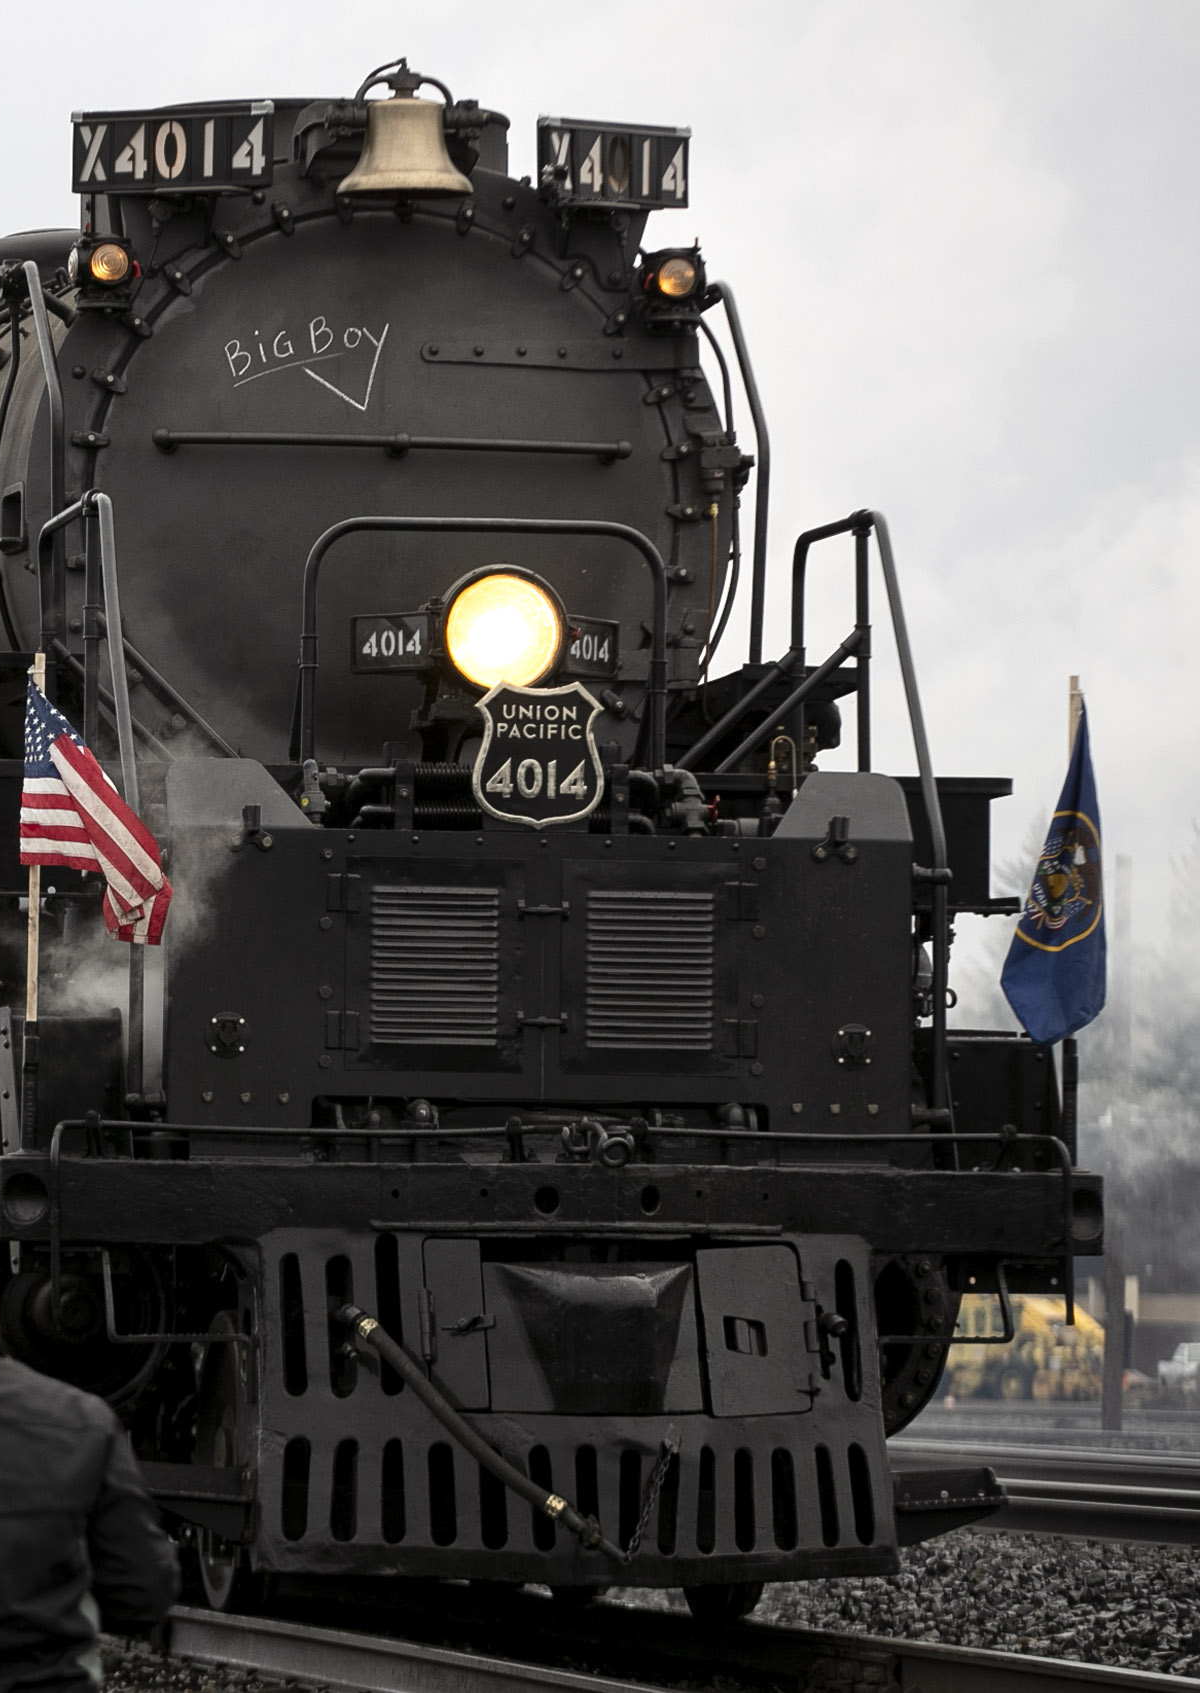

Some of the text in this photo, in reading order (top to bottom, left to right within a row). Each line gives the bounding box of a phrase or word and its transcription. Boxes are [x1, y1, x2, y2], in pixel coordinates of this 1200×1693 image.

[78, 116, 266, 182] X4014
[362, 628, 422, 657] 4014
[570, 634, 609, 663] 4014
[503, 704, 577, 720] UNION
[497, 723, 582, 740] PACIFIC
[486, 757, 588, 800] 4014
[1033, 883, 1048, 907] UTAH
